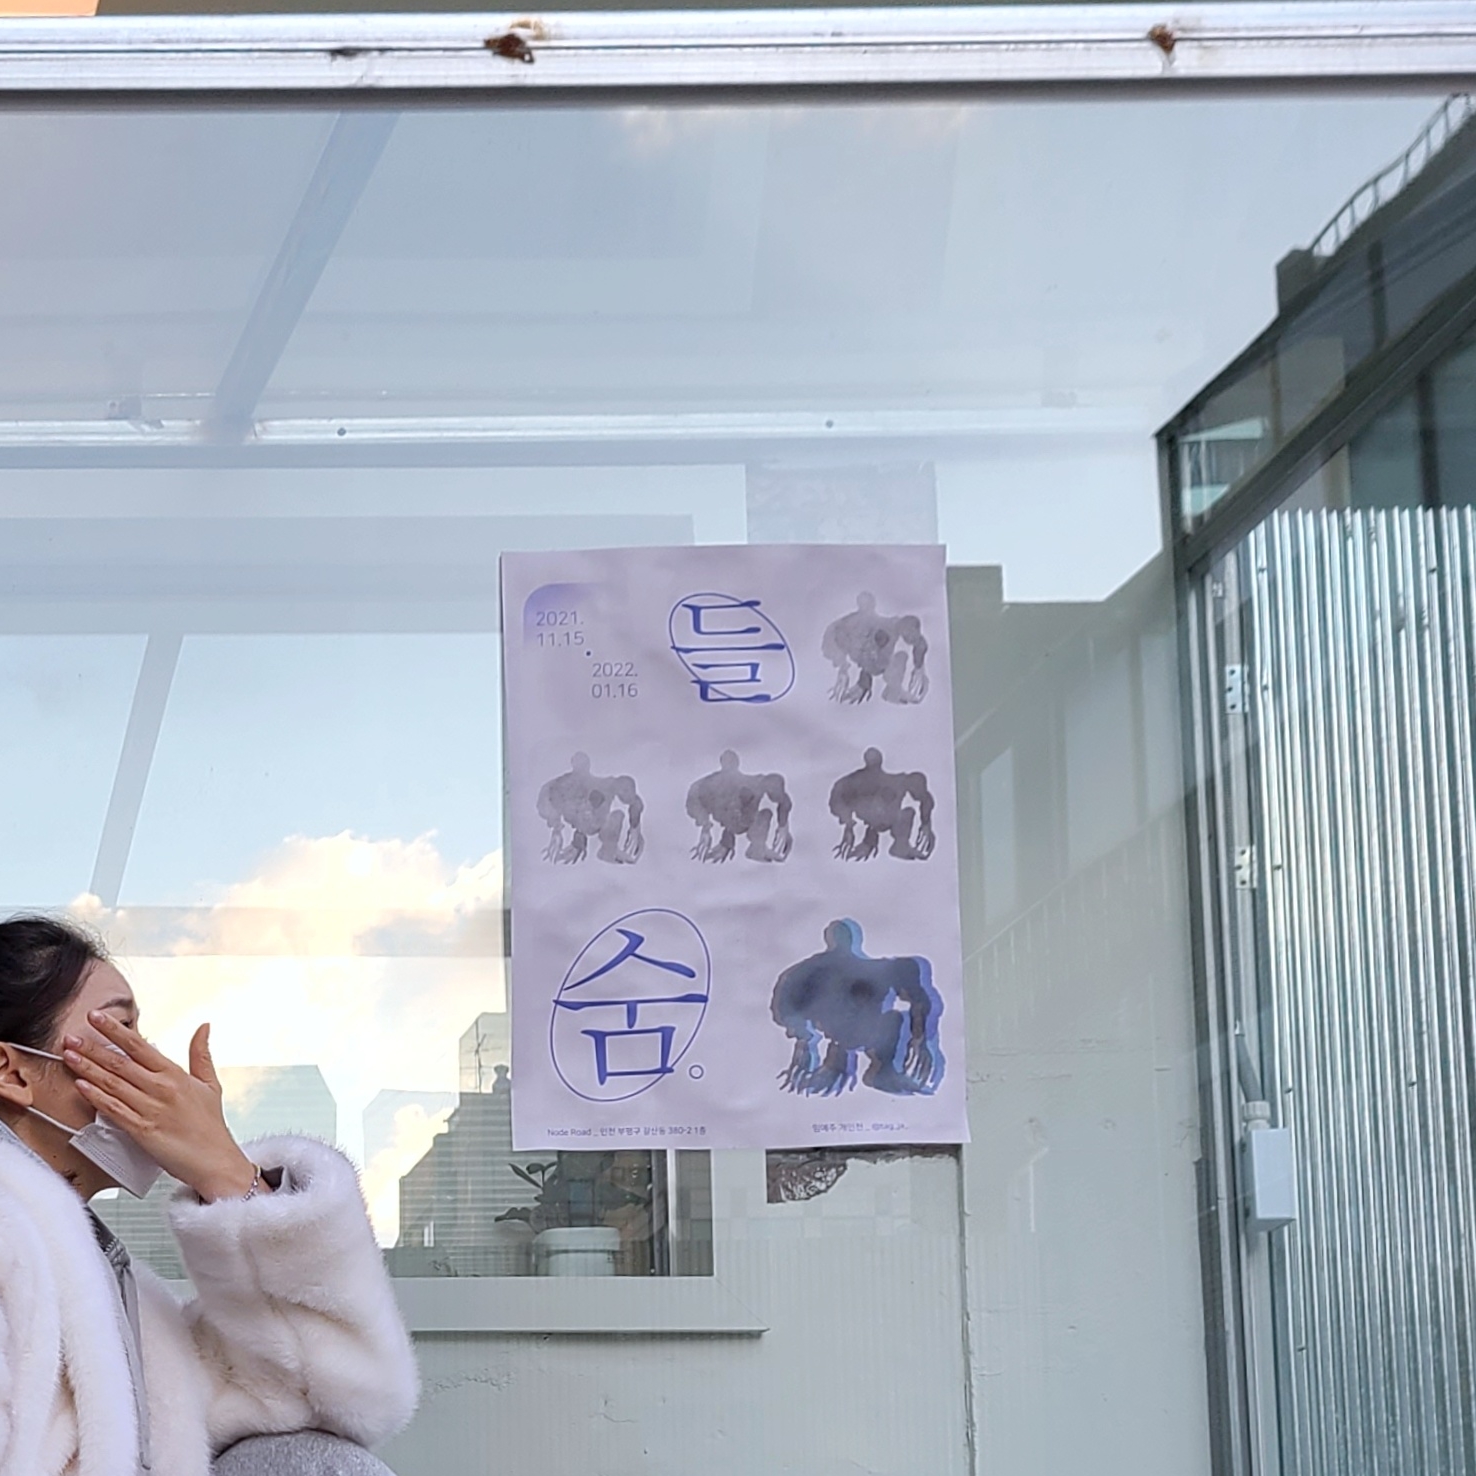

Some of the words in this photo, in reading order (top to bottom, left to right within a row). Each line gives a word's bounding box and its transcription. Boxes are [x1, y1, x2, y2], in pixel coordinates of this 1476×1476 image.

[536, 611, 584, 627] 2021.
[536, 631, 585, 647] 11.15
[671, 600, 785, 703] 들
[592, 662, 638, 677] 2022.
[591, 683, 638, 698] 01.16
[547, 1128, 569, 1137] Node
[570, 1127, 592, 1137] Road
